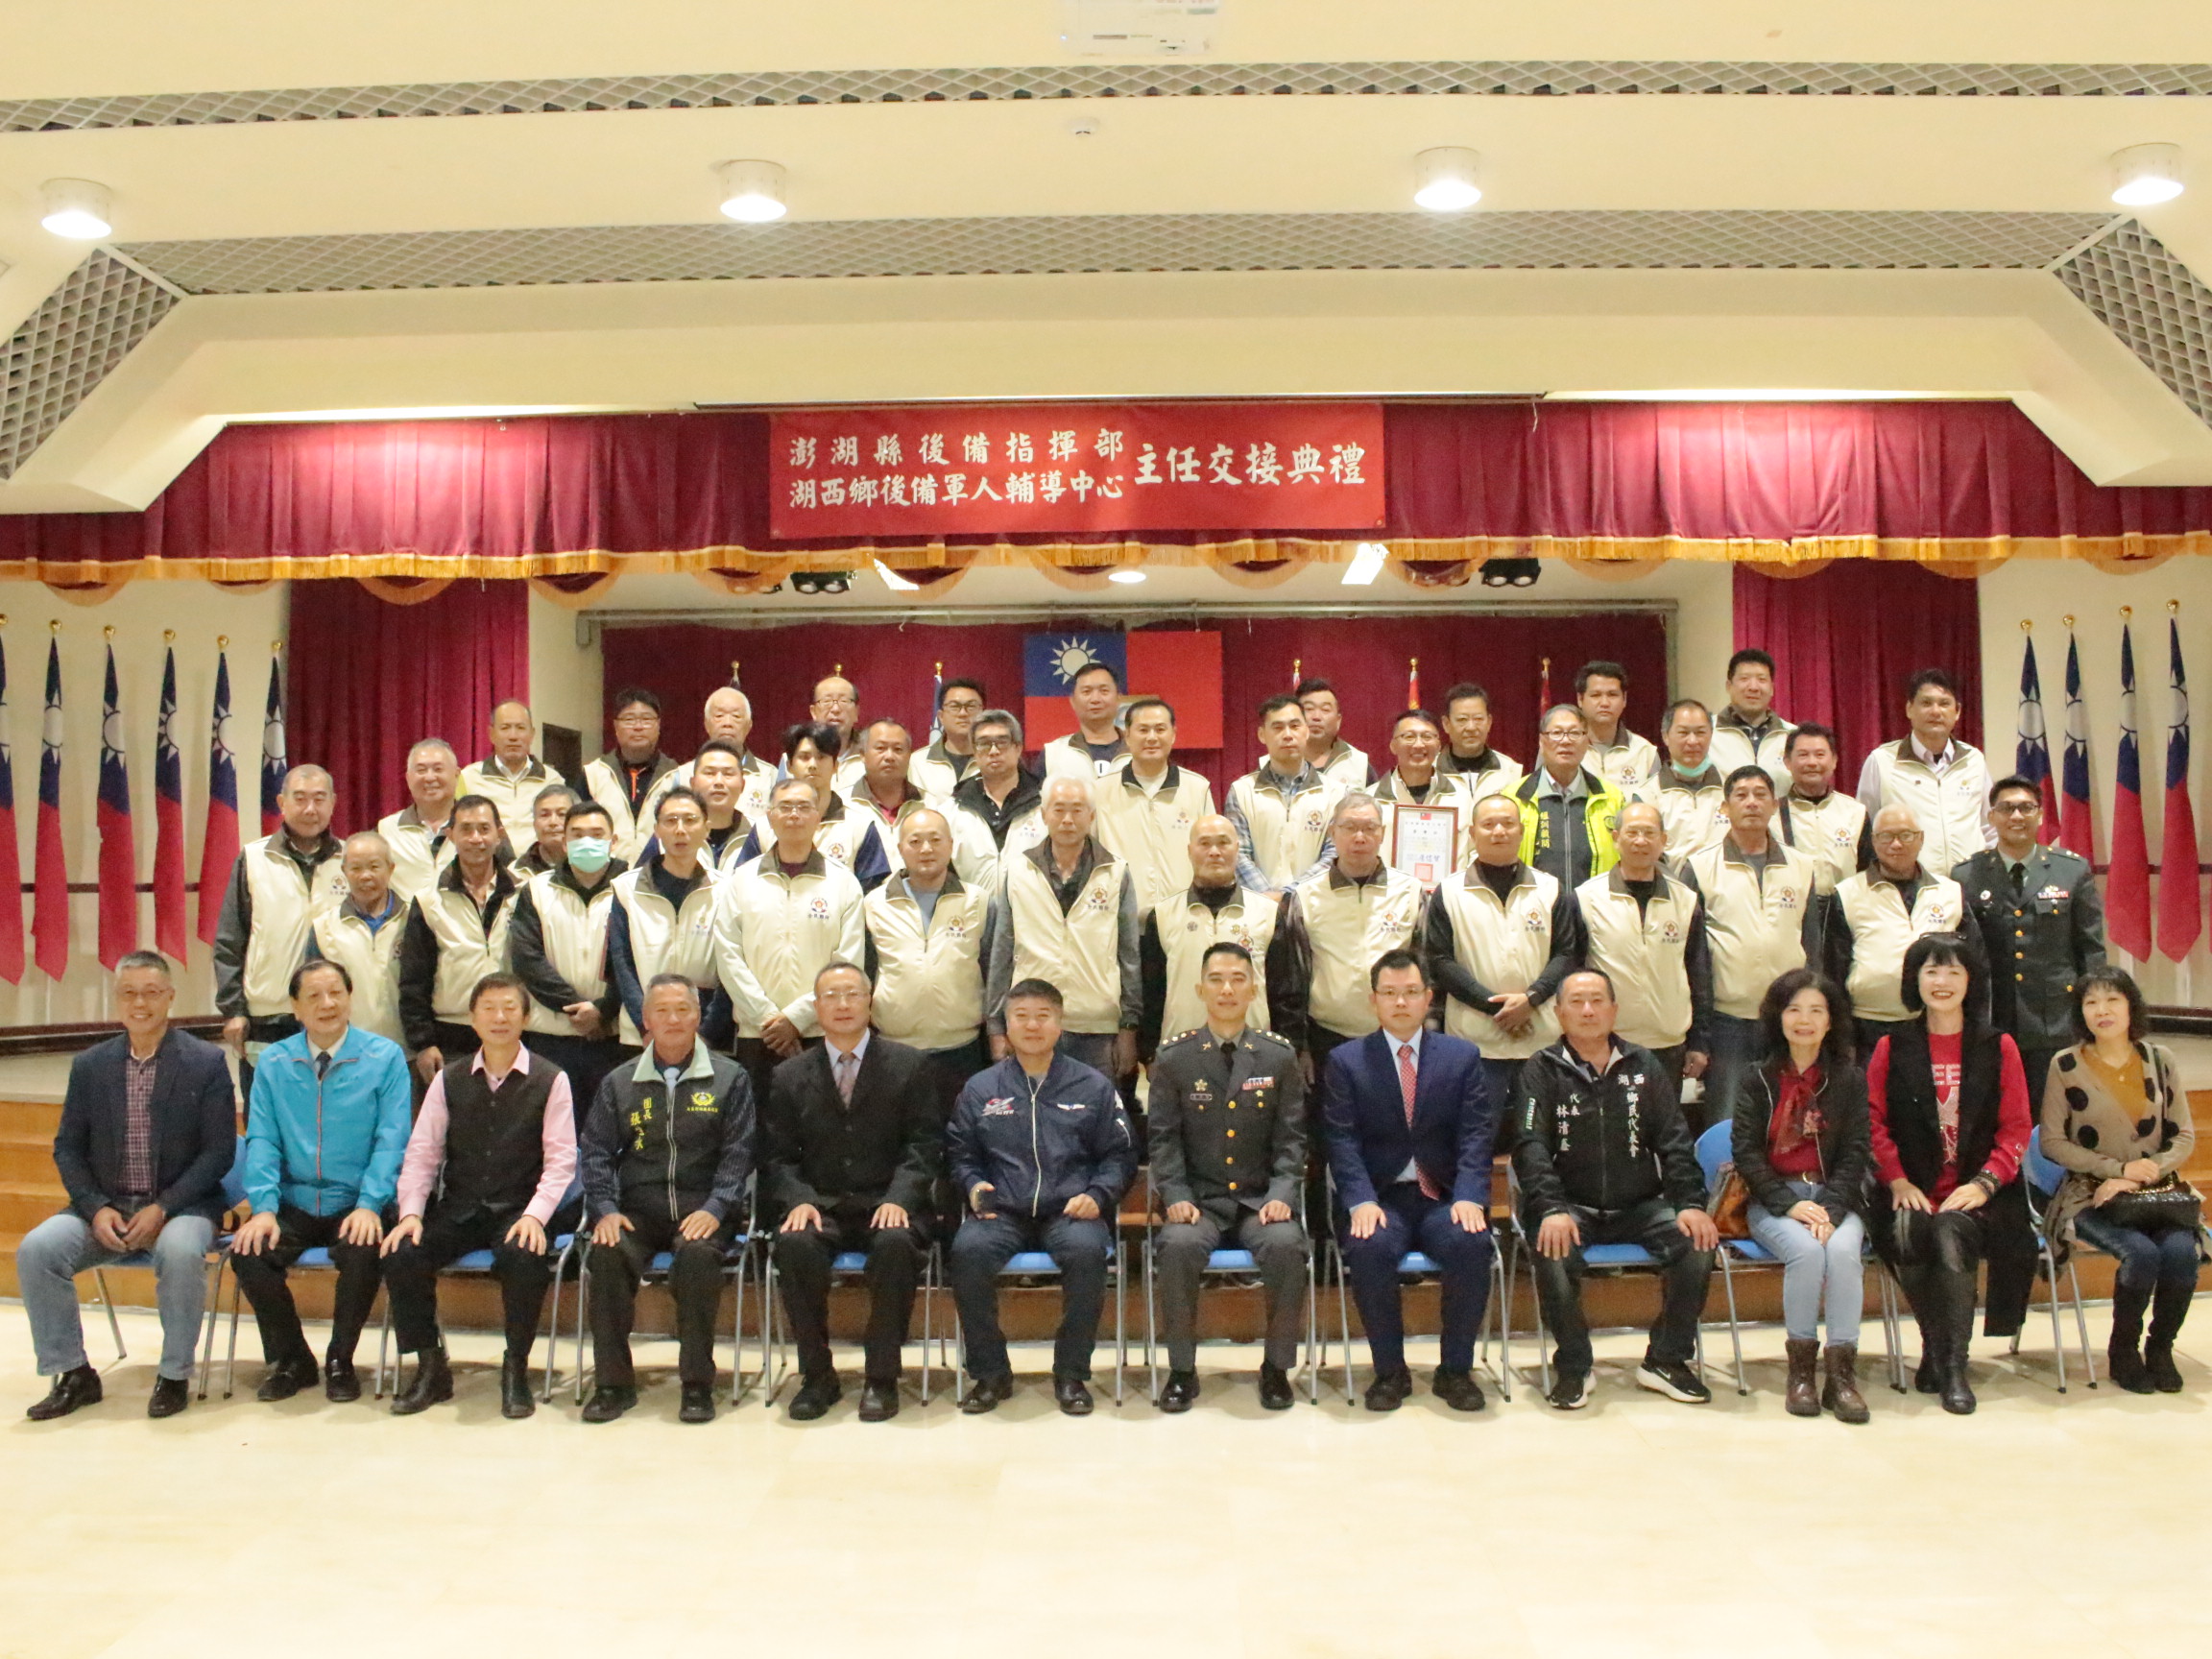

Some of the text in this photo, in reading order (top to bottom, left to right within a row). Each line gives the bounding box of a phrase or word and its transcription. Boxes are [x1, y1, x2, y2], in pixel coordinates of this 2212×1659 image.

[789, 429, 1123, 468] 澎湖縣後備指揮部
[1134, 442, 1366, 487] 主任交接典禮
[789, 469, 1123, 508] 湖西鄉後備軍人輔導中心
